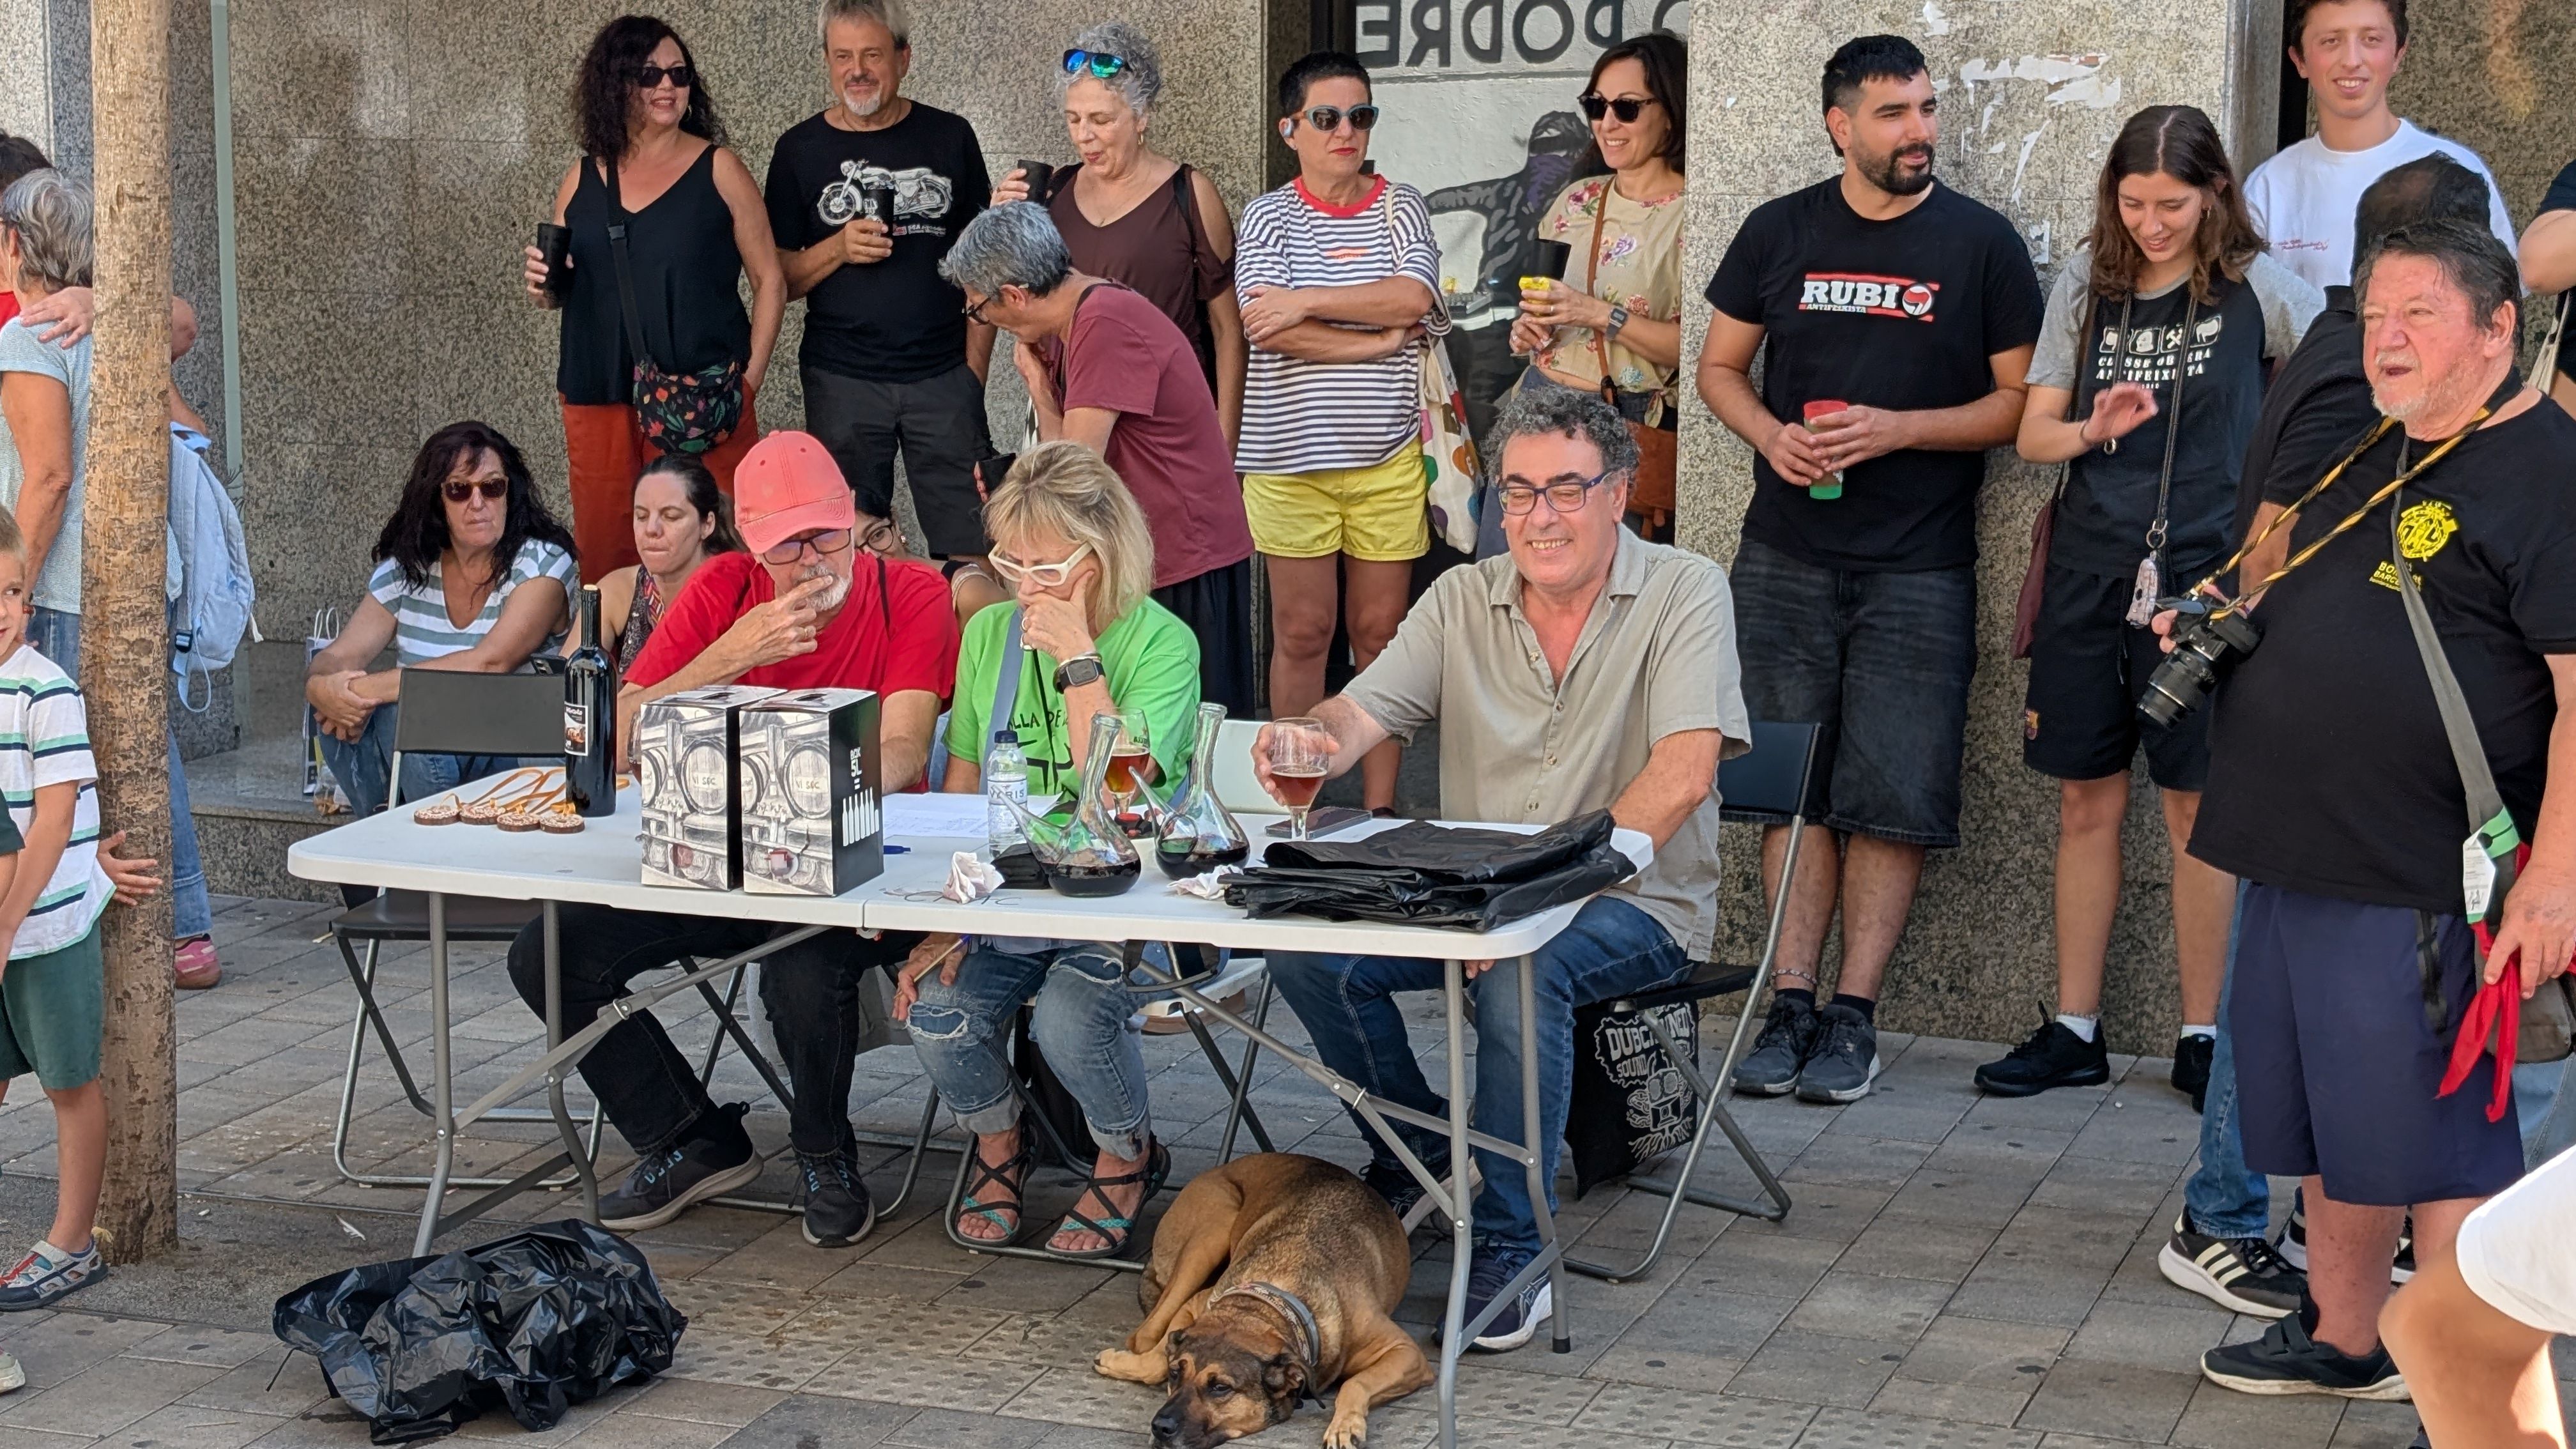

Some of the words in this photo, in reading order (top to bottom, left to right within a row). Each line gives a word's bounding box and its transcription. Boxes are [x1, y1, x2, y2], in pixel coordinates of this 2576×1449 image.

[2098, 356, 2151, 369] CLSSE
[2157, 348, 2211, 366] OBERA
[850, 758, 862, 778] 5L
[1616, 1054, 1648, 1078] SOUND
